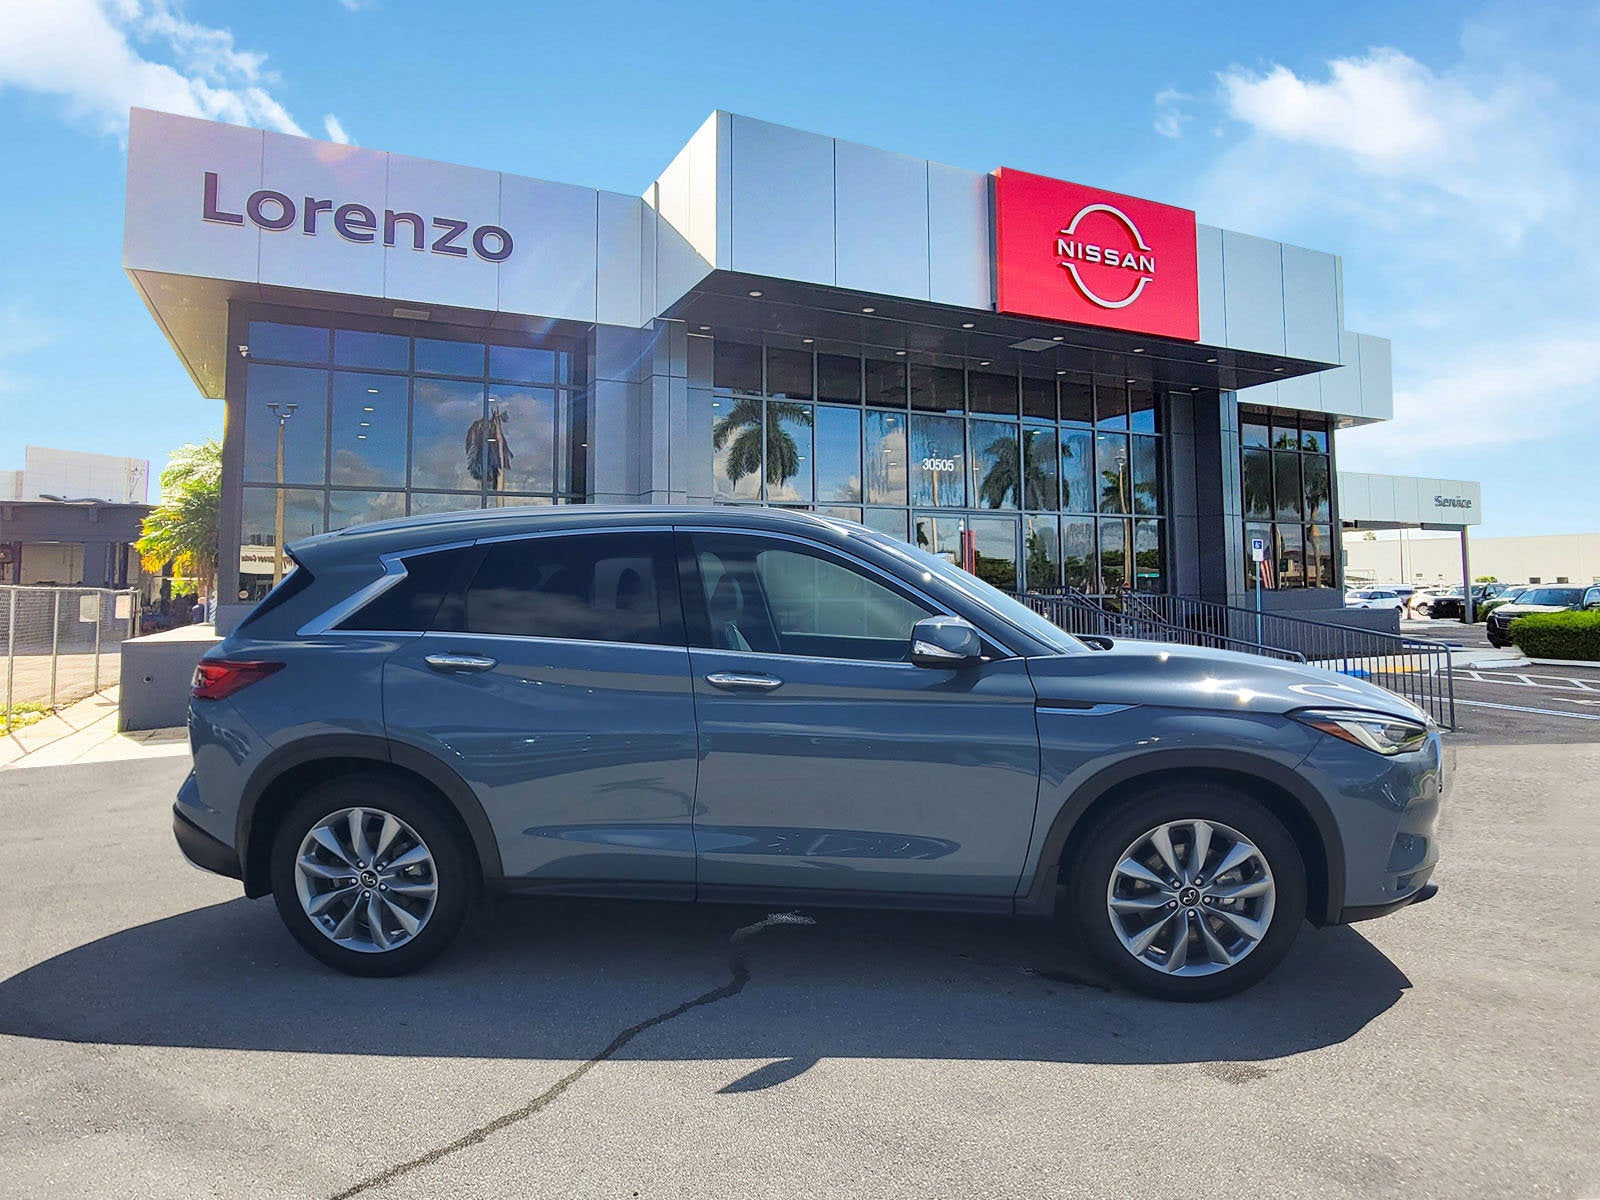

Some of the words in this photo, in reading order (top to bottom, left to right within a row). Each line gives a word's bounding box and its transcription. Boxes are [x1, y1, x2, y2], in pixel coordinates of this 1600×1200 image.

[202, 171, 514, 262] Lorenzo
[1057, 238, 1155, 273] NISSAN
[922, 457, 955, 472] 30505
[1434, 495, 1472, 508] Service
